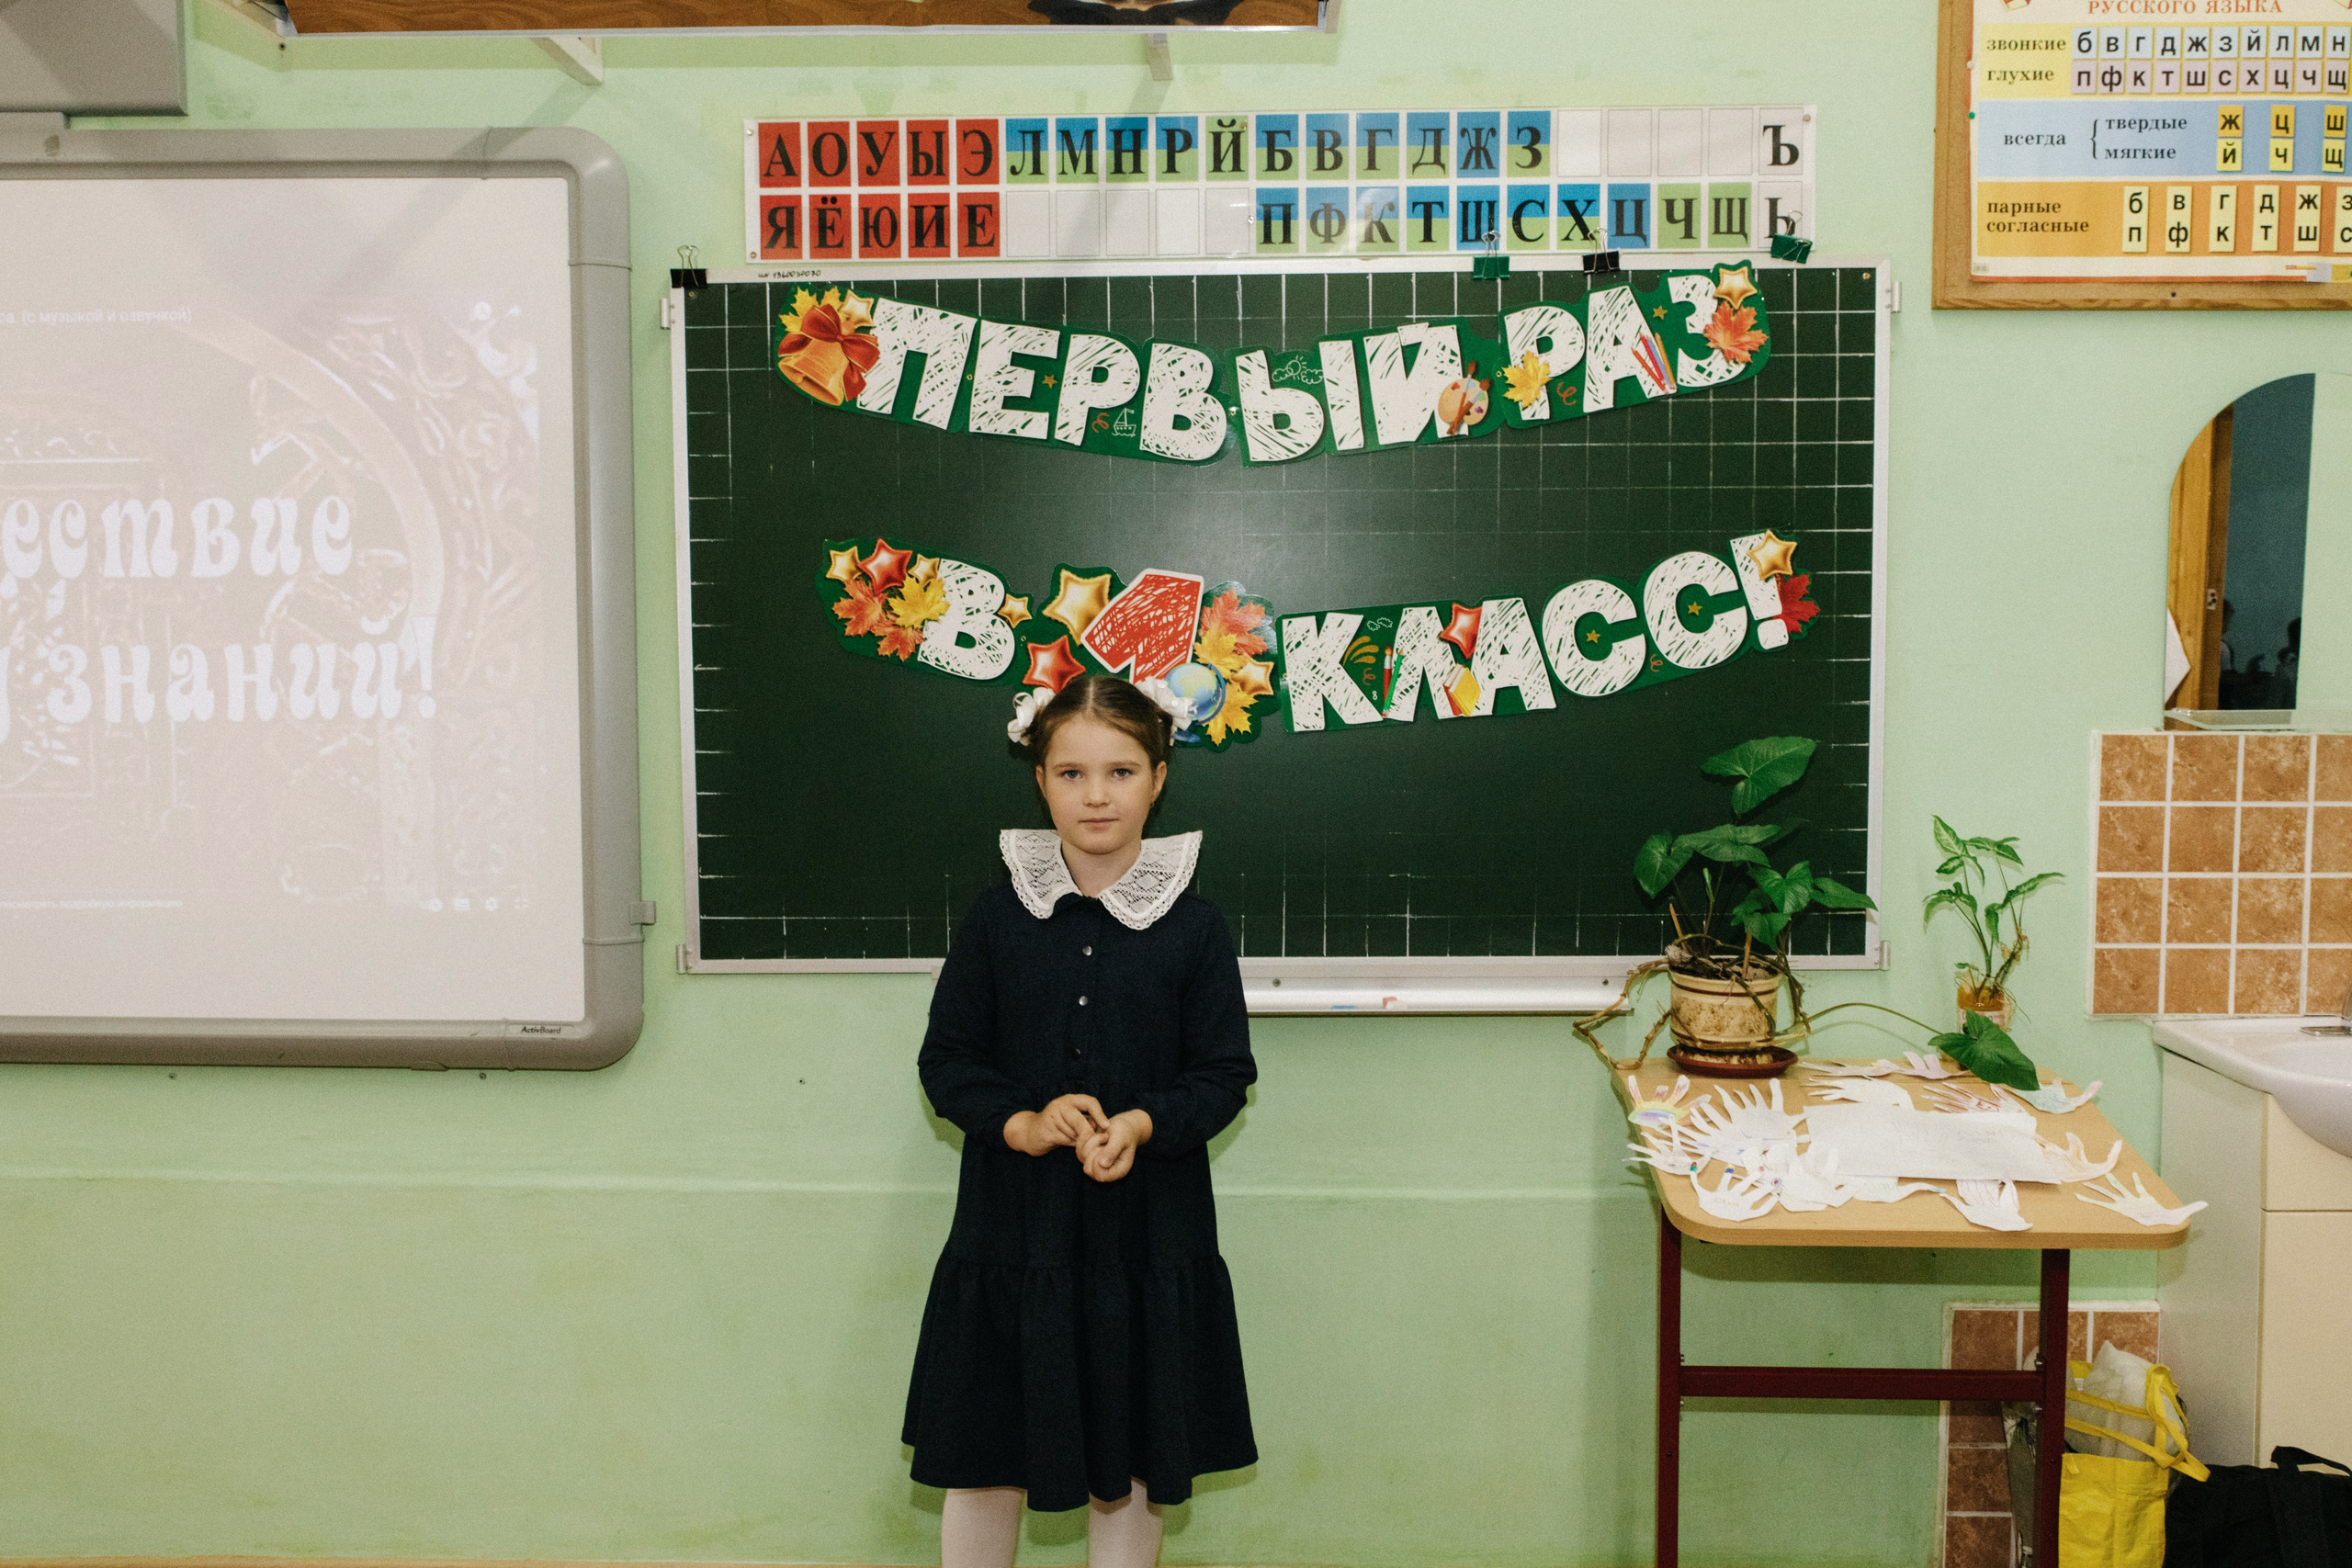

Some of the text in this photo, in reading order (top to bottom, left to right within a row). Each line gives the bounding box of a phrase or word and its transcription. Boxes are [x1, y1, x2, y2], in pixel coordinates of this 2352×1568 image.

[2087, 0, 2283, 15] РУССКОГО ЯЗЫКА
[1987, 38, 2066, 51] звонкие
[1987, 69, 2054, 82] глухие
[2105, 117, 2188, 133] твердые
[2004, 134, 2066, 147] всегда
[2105, 147, 2177, 160] мягкие
[1987, 201, 2061, 216] парные
[1986, 220, 2089, 233] согласные
[40, 308, 103, 325] музыкой
[119, 306, 192, 325] озвучкой)
[856, 275, 1747, 461] ПЕРВЫЙ РАЗ
[918, 558, 1016, 681] В
[1282, 532, 1790, 733] КЛАСС!
[46, 615, 437, 725] знаний!
[520, 1025, 562, 1034] ActivBoard
